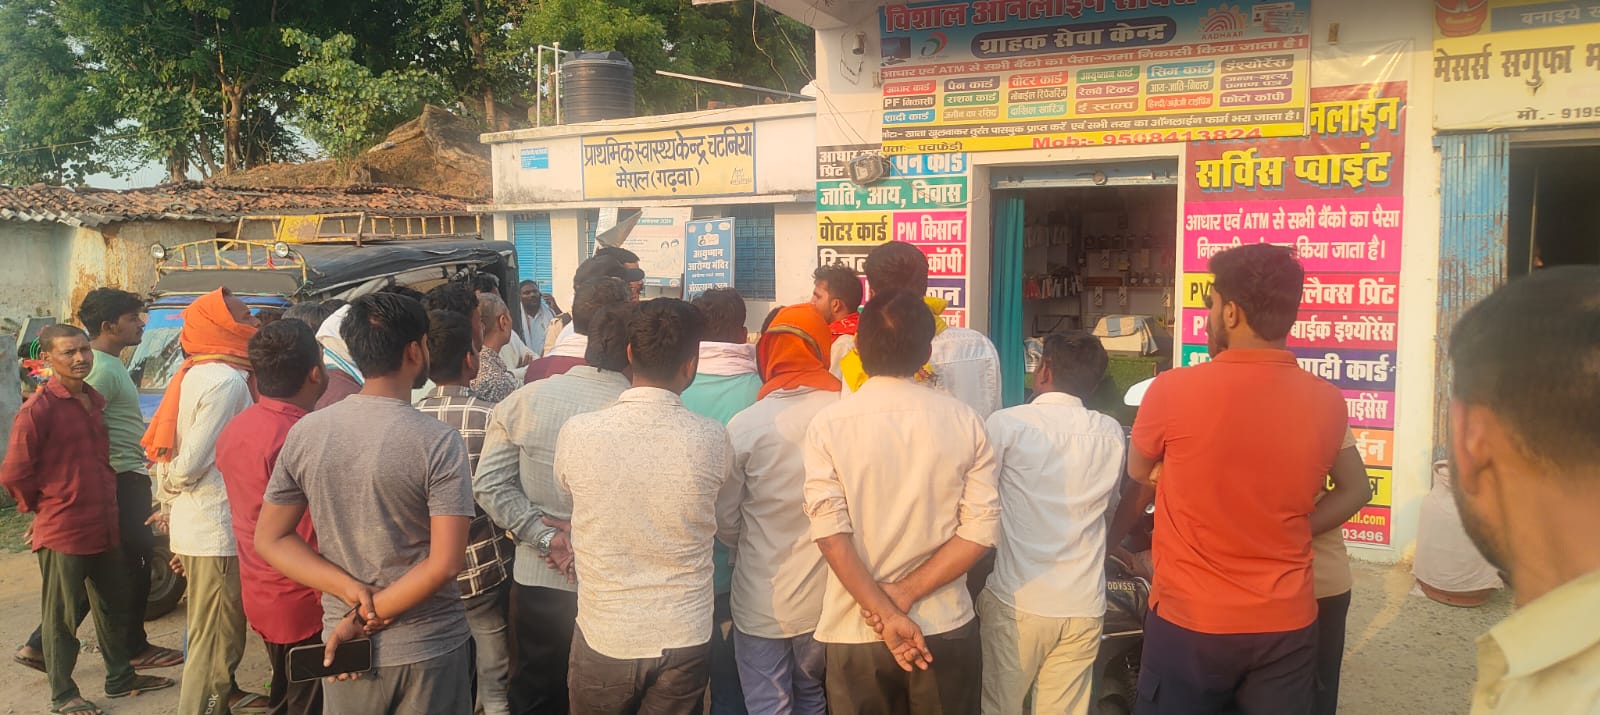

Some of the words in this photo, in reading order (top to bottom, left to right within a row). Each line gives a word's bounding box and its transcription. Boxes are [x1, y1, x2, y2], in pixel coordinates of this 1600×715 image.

[885, 2, 970, 33] विशाल
[979, 34, 1048, 54] ग्राहक
[1053, 28, 1105, 48] सेवा
[1109, 22, 1167, 44] केन्द्र
[1201, 31, 1244, 41] AADHAAR
[882, 70, 915, 79] आधार
[939, 64, 965, 74] ATM
[968, 62, 981, 72] से
[984, 60, 1011, 71] सभी
[1045, 57, 1063, 66] का
[1138, 46, 1196, 58] निकासी
[1197, 42, 1235, 53] किया
[1239, 41, 1280, 51] जाता
[1117, 67, 1135, 78] कार्ड
[1183, 62, 1214, 74] कार्ड
[1433, 43, 1492, 82] मेसर्स
[1500, 45, 1575, 90] सगुफा
[969, 78, 994, 89] कार्ड
[1011, 76, 1038, 87] वोटर
[1039, 72, 1064, 84] कार्ड
[1078, 86, 1103, 97] रेलवे
[1105, 85, 1137, 96] टिकट
[884, 98, 900, 108] PF
[902, 97, 934, 107] निकासी
[946, 95, 973, 104] राशन
[976, 92, 997, 102] कार्ड
[1222, 93, 1253, 104] फोटो
[884, 112, 906, 122] शादी
[908, 111, 930, 120] कार्ड
[905, 130, 926, 138] खाता
[1027, 123, 1048, 134] प्राप्त
[1071, 119, 1087, 130] एवं
[1088, 118, 1108, 129] सभी
[1133, 118, 1149, 128] का
[1204, 112, 1230, 124] फार्म
[1231, 113, 1252, 123] भरा
[1254, 111, 1281, 121] जाता
[1310, 86, 1400, 137] नलाईन
[584, 136, 636, 168] प्राथमिक
[708, 126, 753, 157] चटनियां
[1102, 127, 1262, 145] 9508413824
[895, 153, 923, 174] पन
[1195, 147, 1287, 189] सर्विस
[1292, 141, 1393, 190] प्वाइंट
[615, 166, 650, 192] मेराल
[819, 183, 862, 209] जाति,
[866, 186, 907, 209] आय,
[911, 180, 963, 204] निवास
[818, 215, 854, 241] वोटर
[856, 214, 888, 241] कार्ड
[897, 221, 918, 241] PM
[920, 214, 963, 241] किसान
[1185, 212, 1222, 231] आधार
[1223, 207, 1243, 230] एवं
[1244, 214, 1269, 230] ATM
[1272, 207, 1285, 229] से
[1287, 204, 1315, 229] सभी
[1349, 210, 1368, 228] का
[1371, 203, 1400, 227] पैसा
[927, 247, 964, 273] कॉपी
[1296, 235, 1329, 259] किया
[1331, 241, 1366, 258] जाता
[1300, 276, 1355, 305] लैक्स
[1358, 276, 1397, 305] प्रिंट
[1345, 353, 1390, 382] कार्ड
[1344, 392, 1389, 422] ाईसेंस
[1347, 511, 1386, 526] il.com
[1341, 528, 1384, 543] 03496
